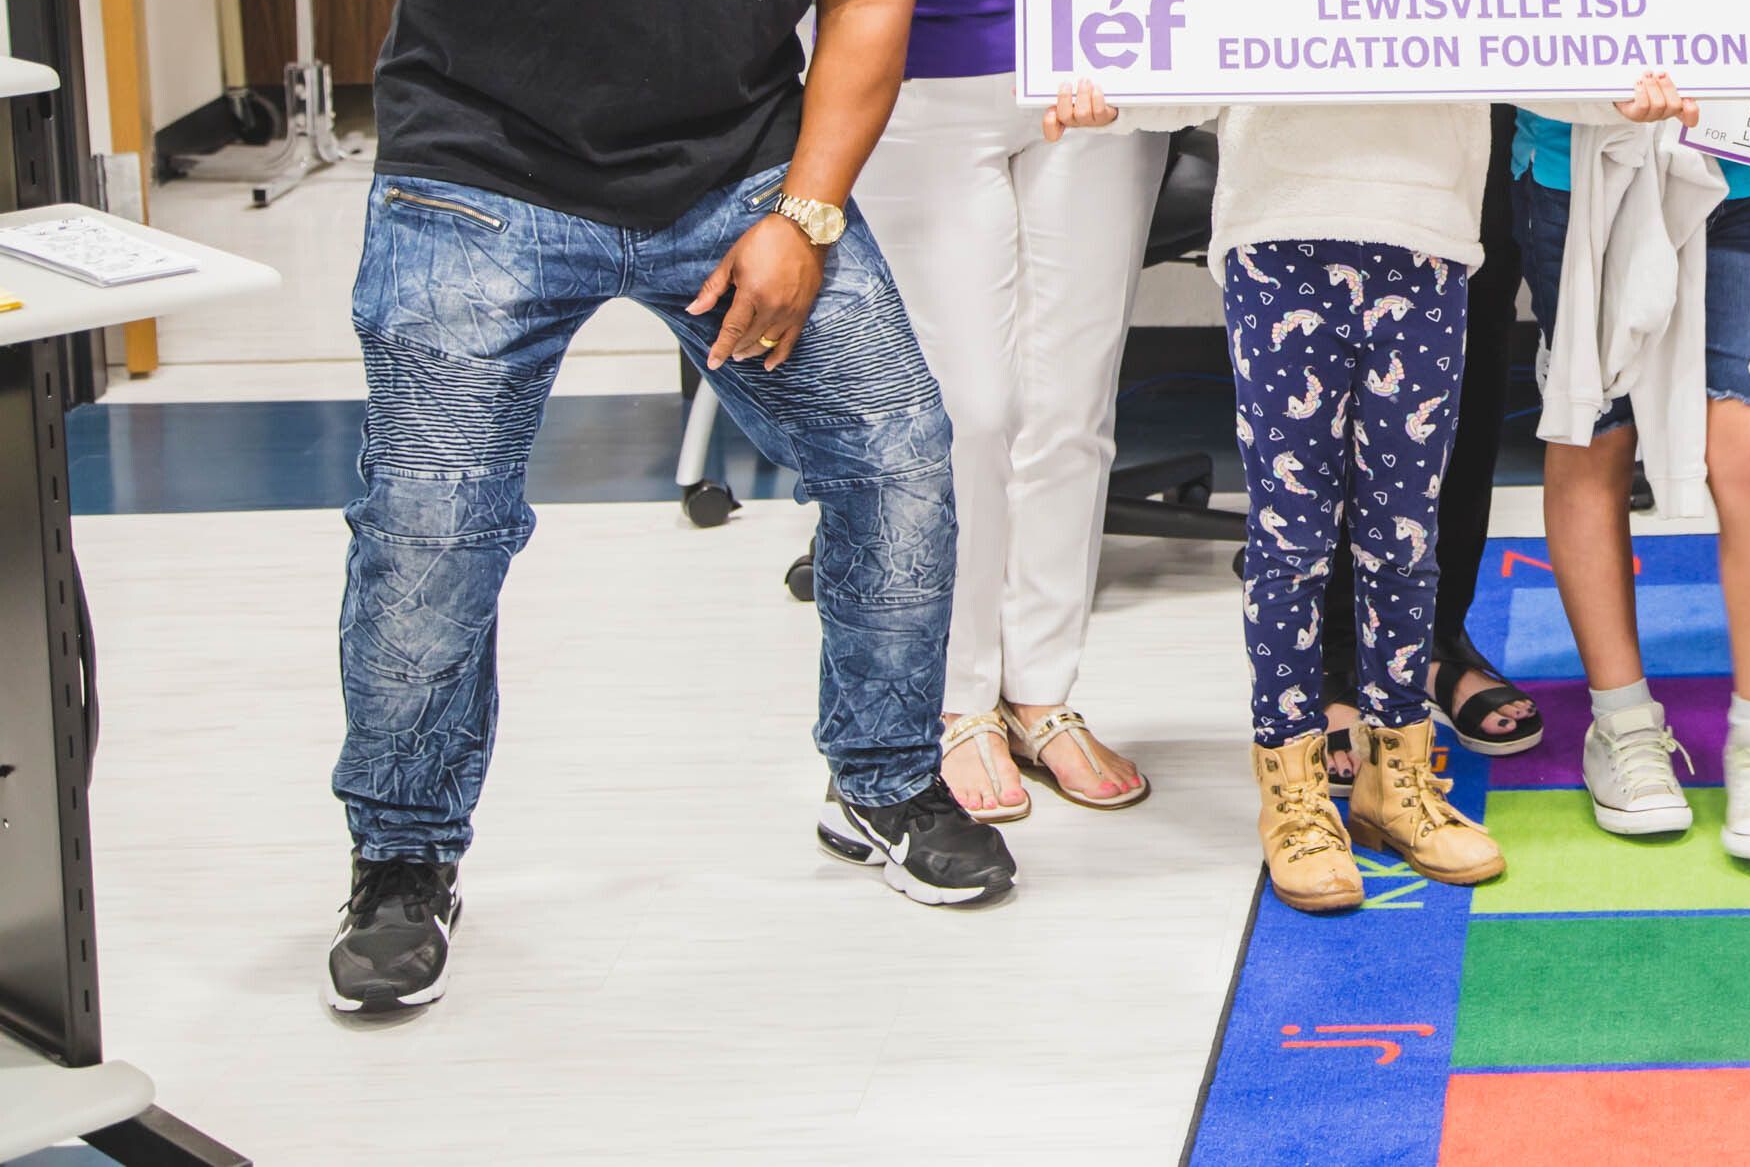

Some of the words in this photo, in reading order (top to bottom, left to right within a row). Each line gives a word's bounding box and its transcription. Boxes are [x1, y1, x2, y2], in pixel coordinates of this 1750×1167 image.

[1218, 35, 1460, 70] EDUCATION
[1479, 33, 1749, 67] FOUNDATION
[1704, 128, 1728, 142] FOR
